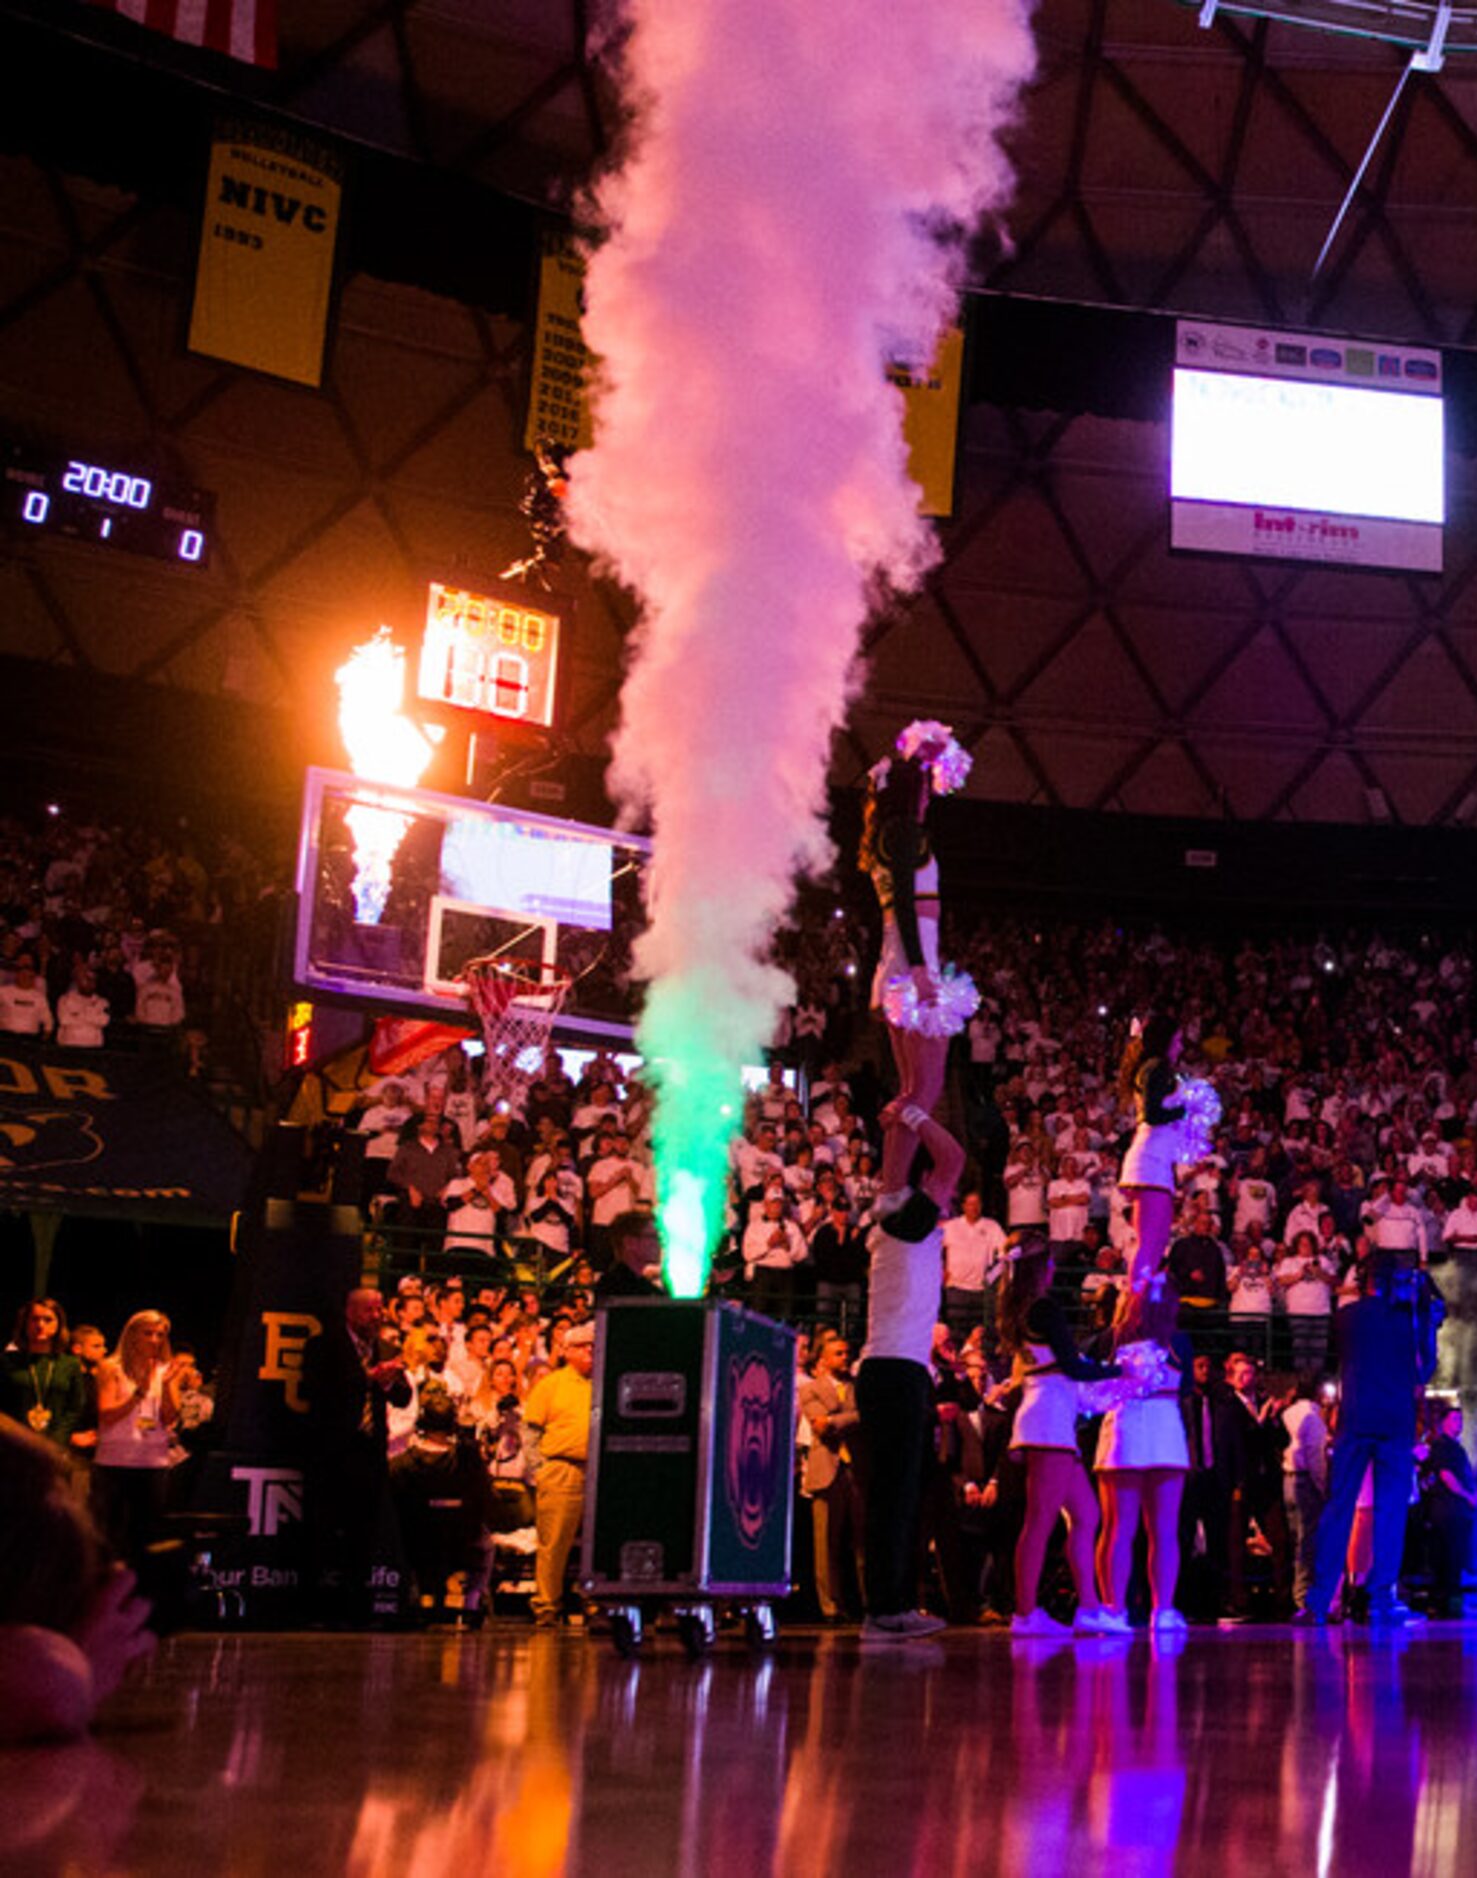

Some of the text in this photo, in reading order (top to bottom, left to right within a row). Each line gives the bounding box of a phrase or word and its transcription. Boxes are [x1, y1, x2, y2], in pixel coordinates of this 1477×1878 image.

[218, 176, 327, 233] NIVC
[62, 459, 152, 510] 20:00
[22, 489, 51, 525] 0
[1253, 510, 1360, 540] Intrim
[178, 528, 205, 562] 0
[250, 1563, 300, 1590] Ban
